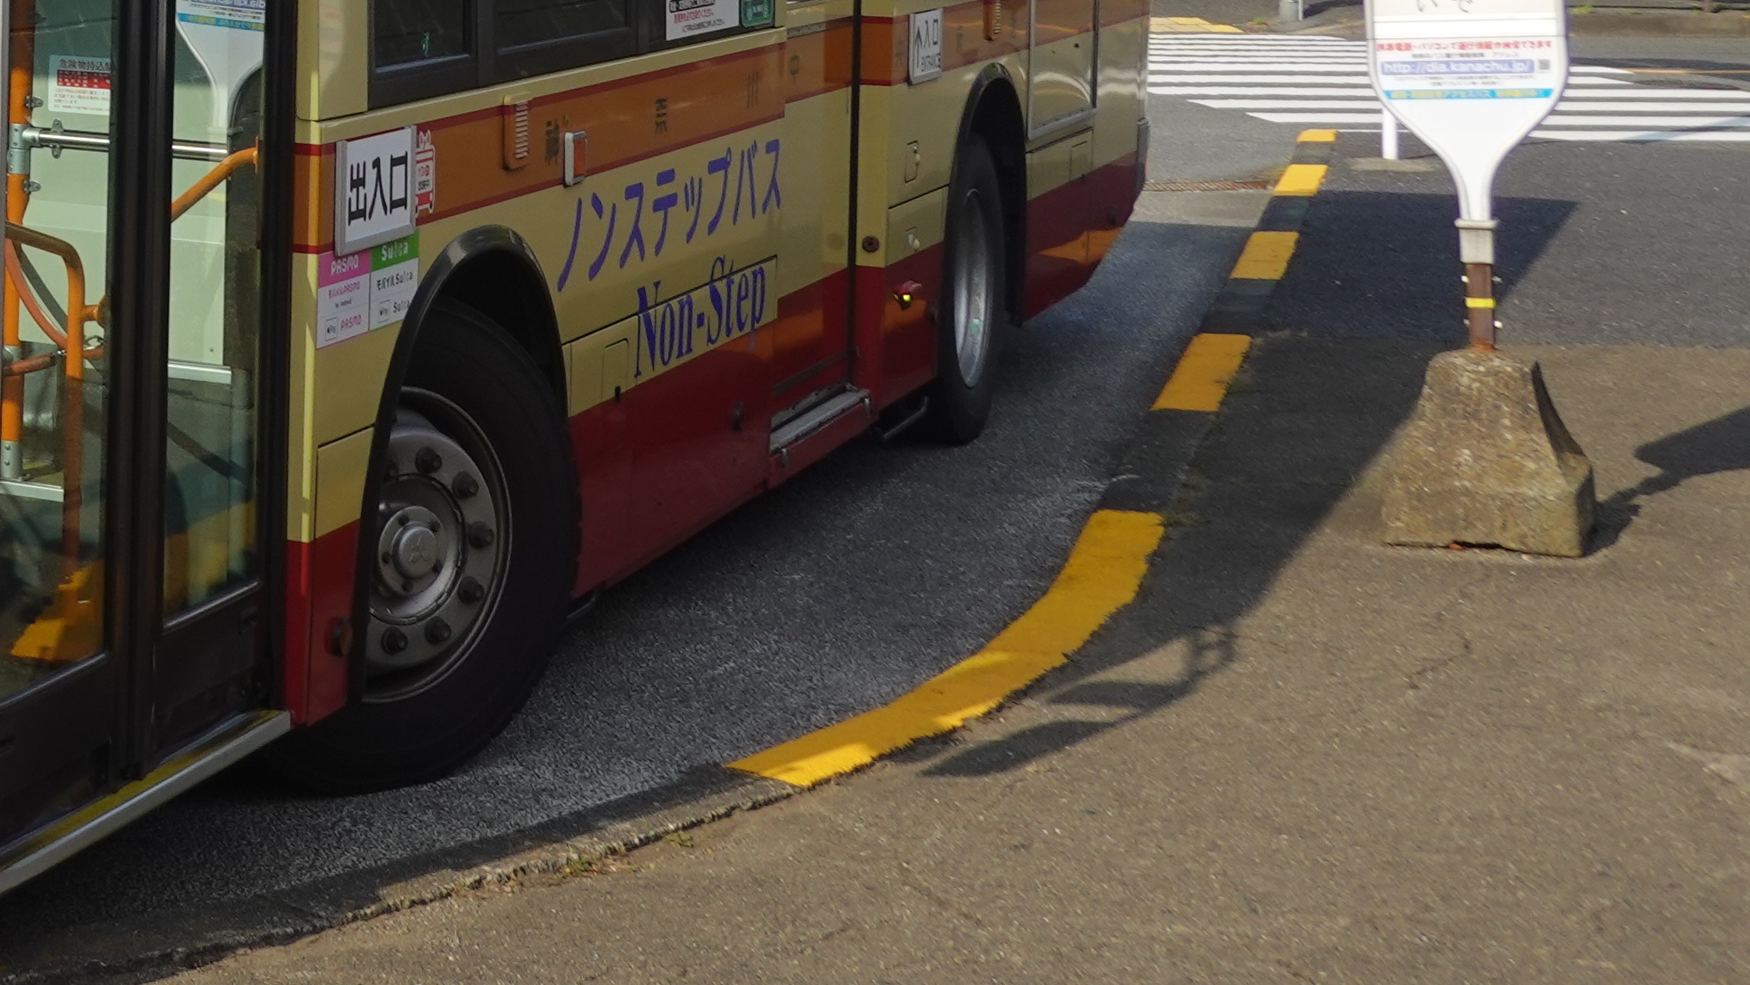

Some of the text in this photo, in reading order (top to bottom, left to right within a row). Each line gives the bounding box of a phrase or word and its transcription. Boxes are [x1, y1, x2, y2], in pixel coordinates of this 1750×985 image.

[924, 18, 939, 49] 入口
[1384, 60, 1532, 74] http://dia.kanachu.jp/
[348, 150, 408, 226] 出入口
[557, 138, 782, 293] ノンステップバス
[381, 240, 409, 261] Suica
[331, 254, 360, 276] PASMO
[377, 270, 414, 291] モバイルSuica
[393, 298, 410, 314] Suica
[634, 253, 767, 378] Non-Step
[340, 314, 362, 332] PASMO
